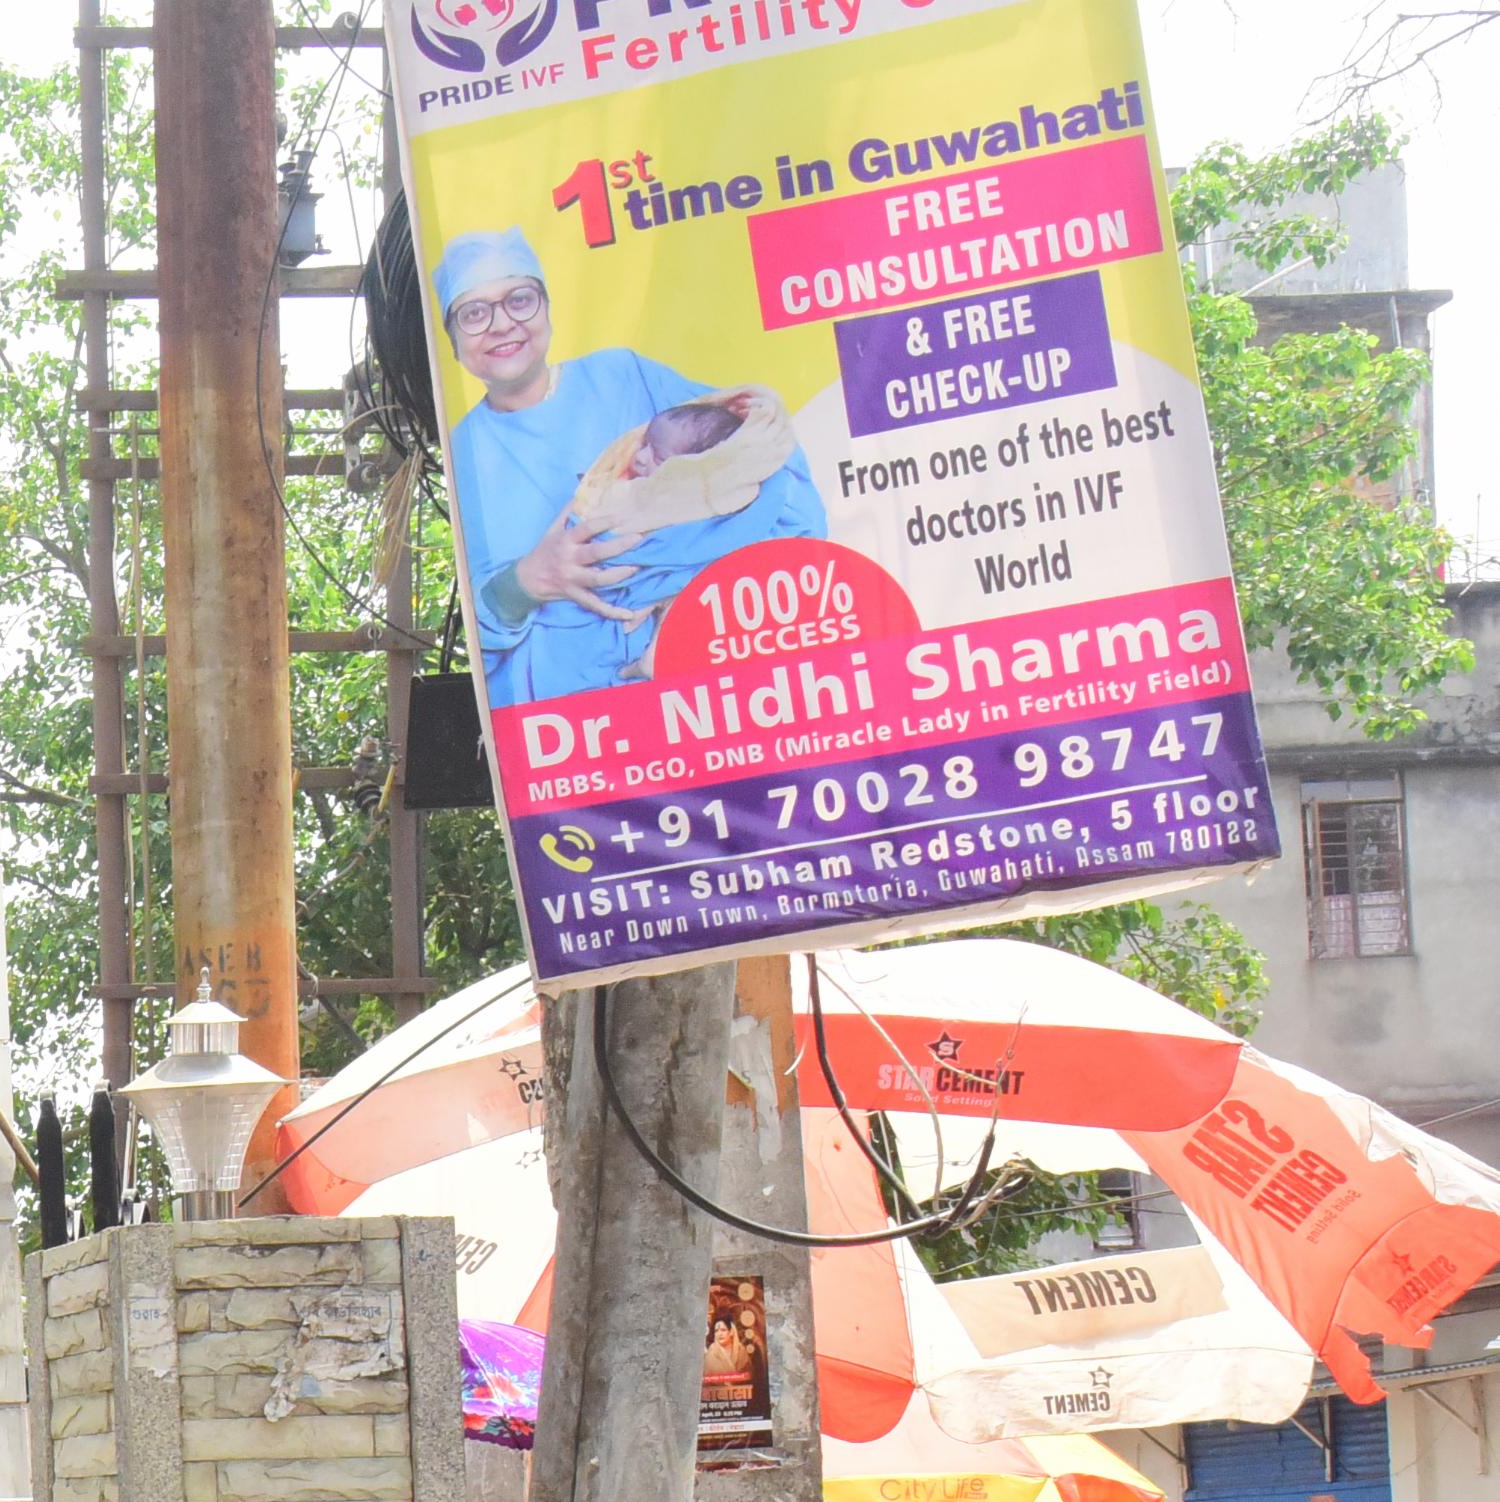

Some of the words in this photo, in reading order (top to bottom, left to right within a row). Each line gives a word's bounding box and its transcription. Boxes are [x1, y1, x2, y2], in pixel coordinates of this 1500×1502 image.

[418, 74, 514, 113] PRIDE
[521, 62, 566, 91] IVF
[623, 174, 763, 231] time
[775, 154, 834, 200] in
[848, 80, 1146, 183] Guwahati
[885, 176, 1004, 237] FREE
[781, 209, 1130, 315] CONSULTATION
[905, 316, 931, 357] &
[943, 295, 1036, 349] FREE
[884, 347, 1073, 420] CHECK-UP
[837, 455, 921, 499] From
[929, 443, 988, 481] one
[998, 423, 1030, 468] of
[1039, 418, 1094, 460] the
[1101, 400, 1175, 449] best
[906, 498, 1027, 547] doctors
[1033, 482, 1067, 523] in
[1074, 470, 1126, 516] IVF
[698, 560, 854, 637] 100%
[974, 539, 1073, 595] World
[707, 613, 862, 665] SUCCESS
[521, 710, 630, 769] Dr.
[659, 651, 875, 745] Nidhi
[905, 608, 1221, 701] Sharma
[527, 770, 615, 803] MBBS,
[625, 758, 696, 786] DGO,
[704, 742, 765, 772] DNB
[775, 720, 892, 763] (Miracle
[901, 703, 970, 737] Lady
[981, 700, 1008, 724] in
[1018, 679, 1137, 717] Fertility
[1148, 658, 1233, 694] Field)
[610, 798, 730, 855] +91
[767, 754, 978, 830] 70028
[1014, 711, 1224, 788] 98747
[541, 879, 672, 926] VISIT:
[689, 851, 853, 899] Subham
[871, 816, 1090, 871] Redstone,
[1110, 799, 1132, 831] 5
[1154, 783, 1259, 825] floor
[559, 926, 614, 955] Near
[626, 915, 689, 943] Down
[698, 902, 768, 930] Town,
[937, 848, 1065, 894] Guwahati,
[1077, 838, 1155, 869] Assam
[1165, 818, 1259, 856] 780122
[942, 1477, 985, 1500] Life
